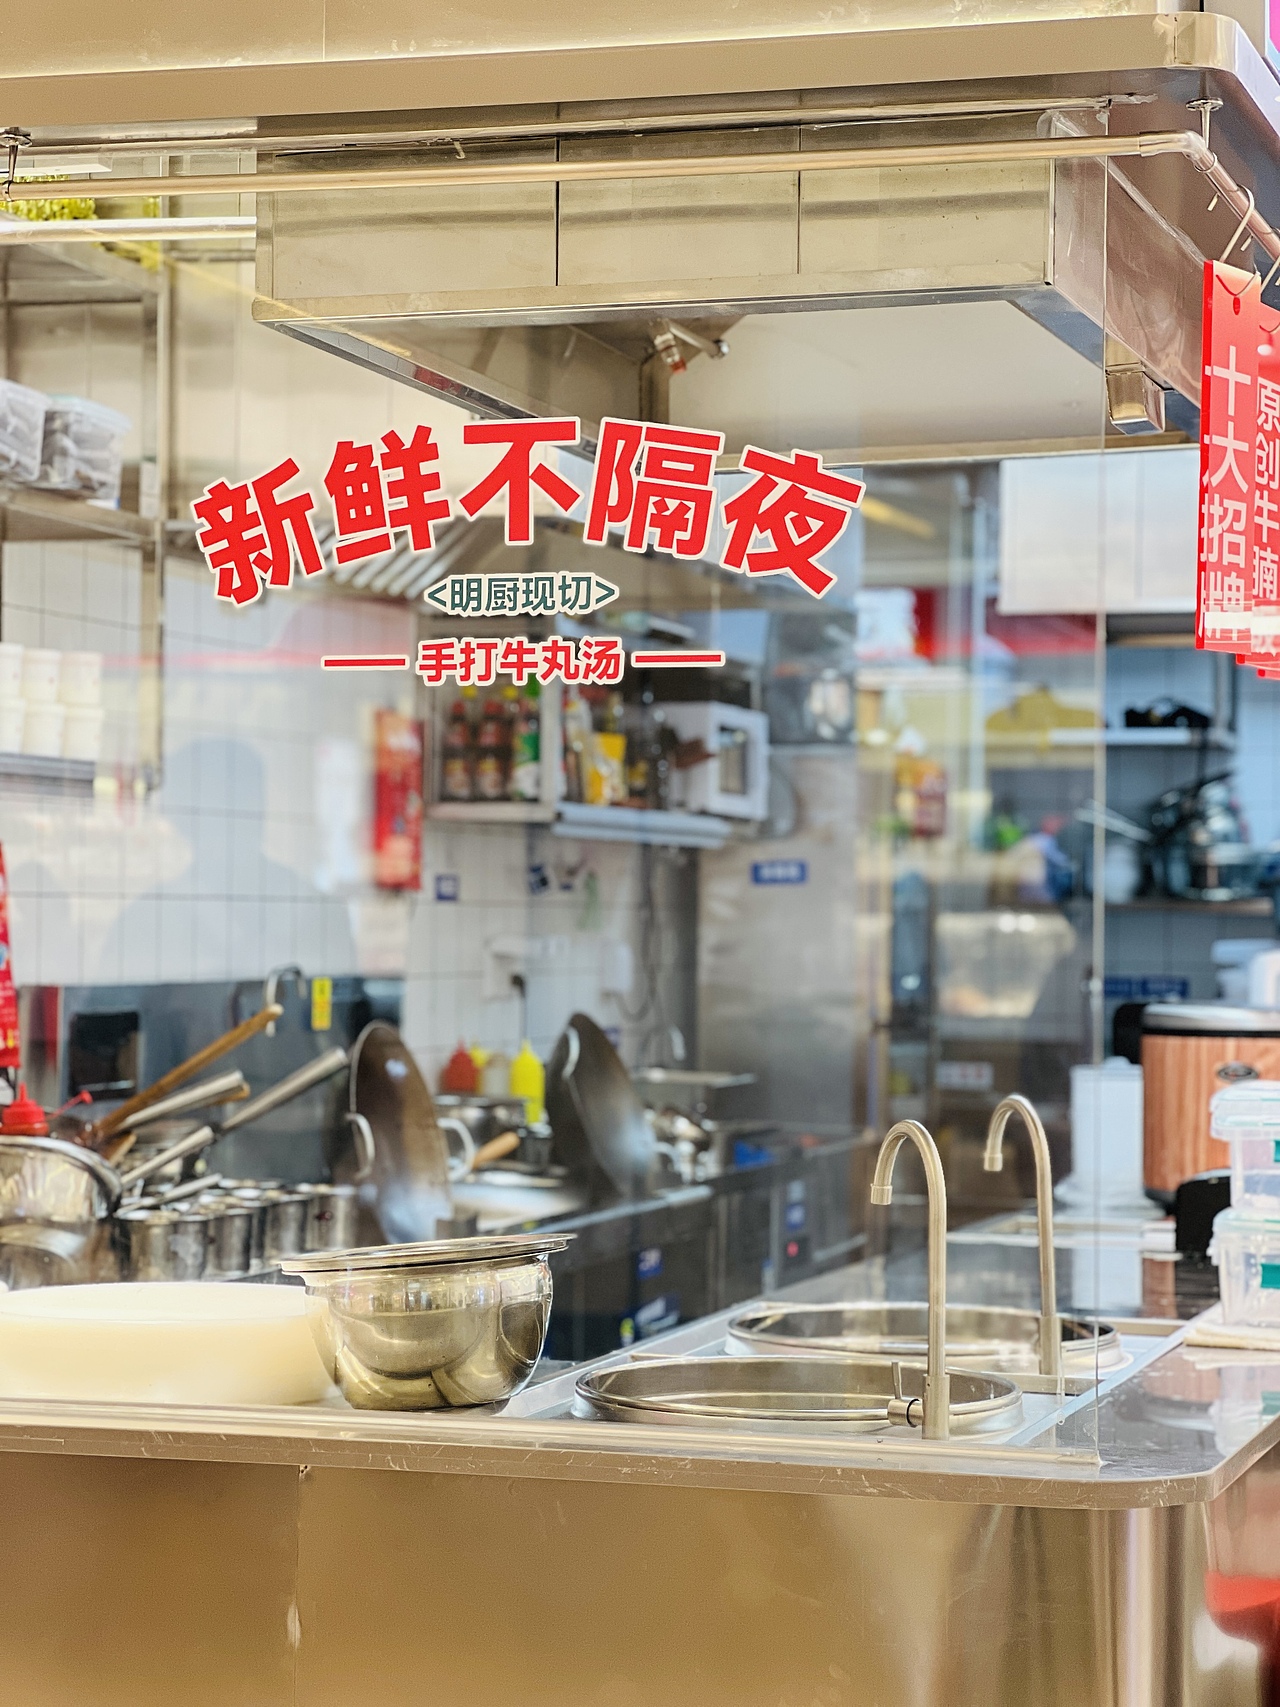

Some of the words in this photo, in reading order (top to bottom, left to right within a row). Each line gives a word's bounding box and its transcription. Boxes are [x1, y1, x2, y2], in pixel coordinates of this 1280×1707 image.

[194, 420, 862, 602] 新鲜不隔夜
[1204, 345, 1251, 642] 十大招牌
[1252, 376, 1280, 657] 原创牛腩
[419, 639, 622, 683] 手打牛丸汤
